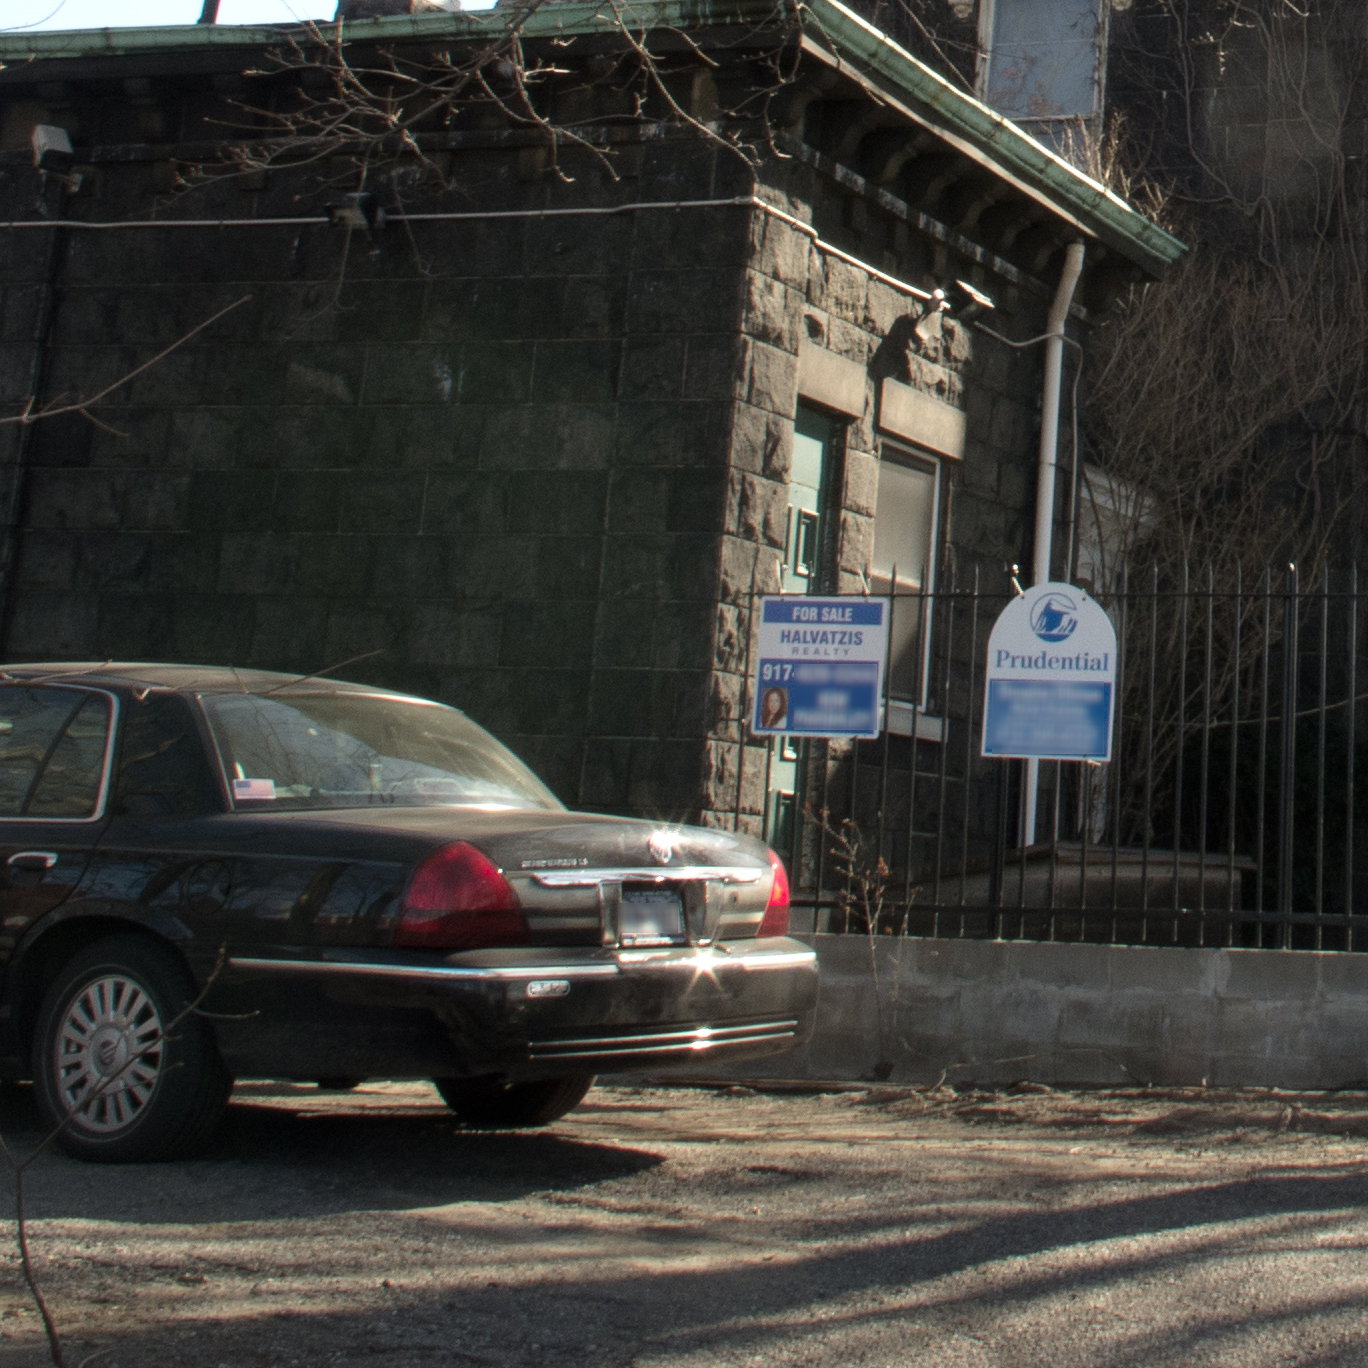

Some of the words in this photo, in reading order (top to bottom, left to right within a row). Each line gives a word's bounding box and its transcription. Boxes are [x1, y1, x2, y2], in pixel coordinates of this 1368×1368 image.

[792, 606, 818, 621] FOR
[821, 607, 853, 622] SALE
[780, 629, 864, 646] HALVATZIS
[791, 646, 851, 656] REALTY
[995, 649, 1109, 672] Prudential
